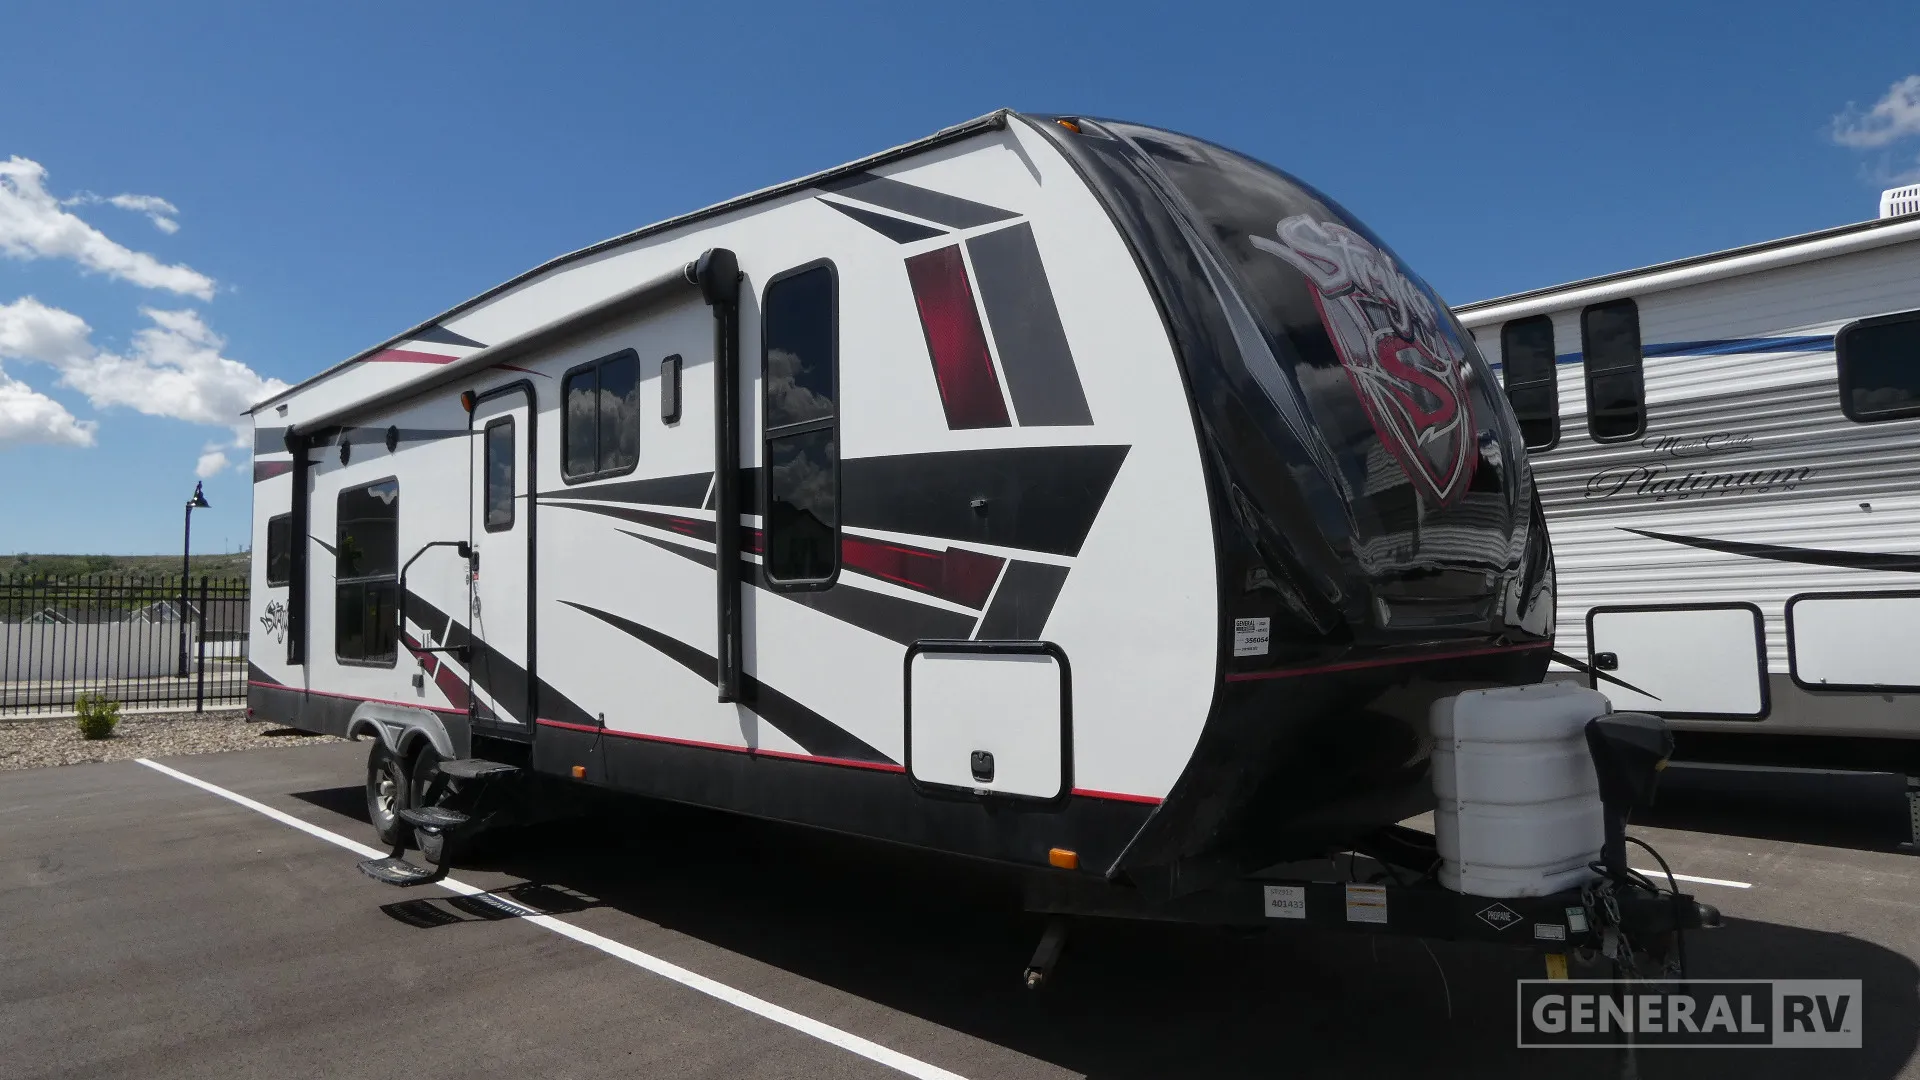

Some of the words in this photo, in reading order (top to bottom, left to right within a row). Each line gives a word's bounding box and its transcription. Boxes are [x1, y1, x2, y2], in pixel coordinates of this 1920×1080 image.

[1584, 463, 1817, 499] Platinum
[1655, 484, 1797, 501] EDITION
[1271, 899, 1304, 908] 401433
[1487, 911, 1511, 921] PROPANE
